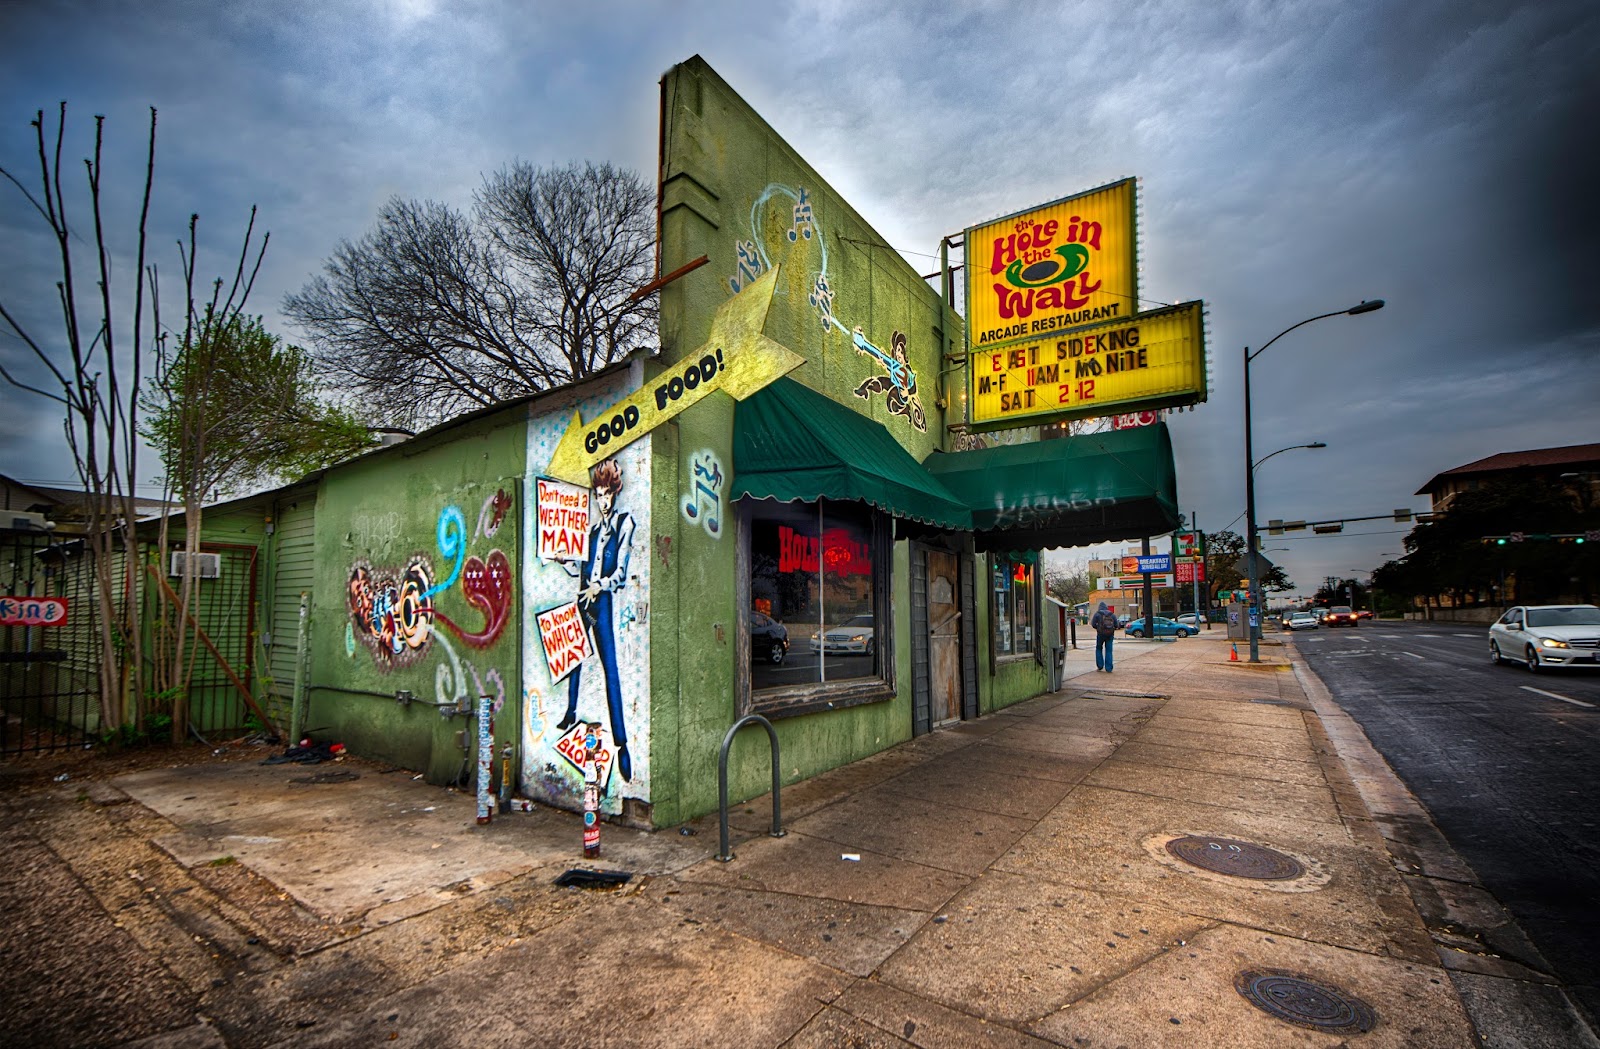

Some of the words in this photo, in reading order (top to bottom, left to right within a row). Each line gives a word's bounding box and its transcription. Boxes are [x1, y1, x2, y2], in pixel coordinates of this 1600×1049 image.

[1014, 219, 1035, 233] the
[1066, 216, 1102, 250] in
[1022, 248, 1051, 264] the
[980, 323, 1028, 343] ARCADE
[1031, 303, 1119, 332] RESTAURANT
[978, 374, 1007, 395] M-F
[585, 405, 640, 454] GOOD
[654, 348, 725, 411] FOOD!
[1001, 389, 1036, 412] SAT
[559, 491, 580, 508] need
[581, 494, 588, 508] a
[542, 528, 584, 556] MAN
[1140, 557, 1169, 565] BREAKFAST
[540, 617, 551, 633] to
[551, 604, 577, 626] know
[543, 620, 583, 657] WHICH
[549, 637, 586, 677] WAY
